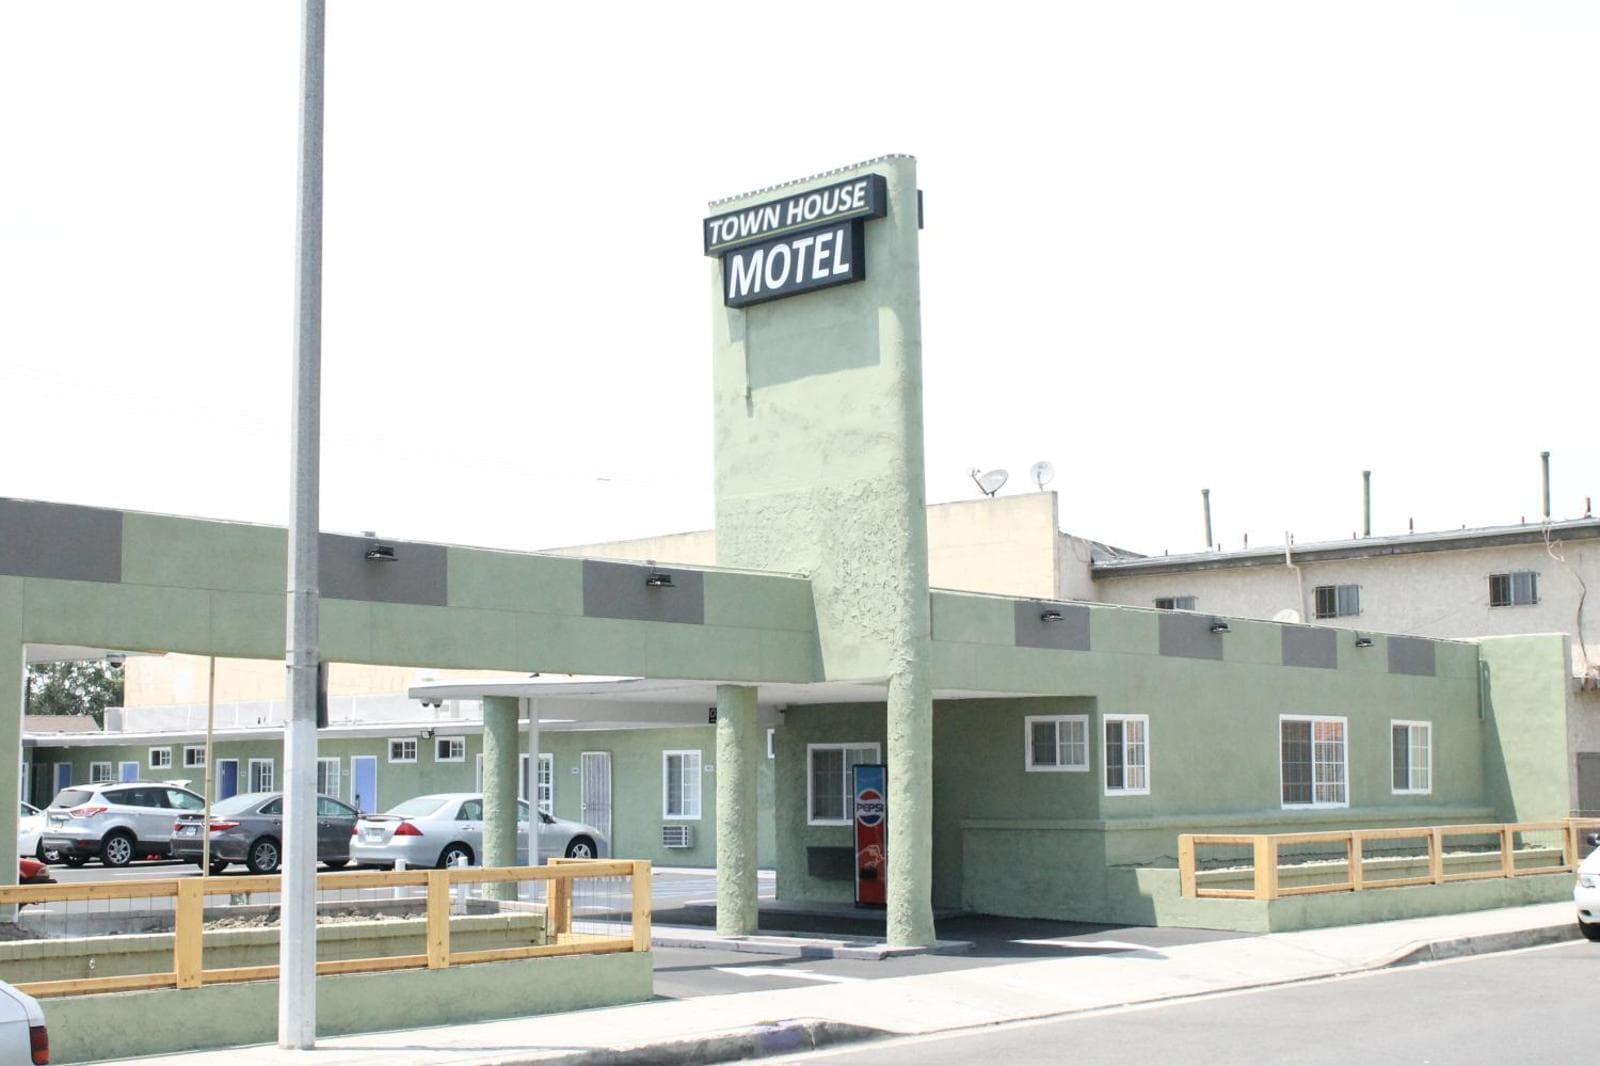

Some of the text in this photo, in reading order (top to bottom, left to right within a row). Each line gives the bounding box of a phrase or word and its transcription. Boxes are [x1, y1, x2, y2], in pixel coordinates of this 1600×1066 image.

[710, 181, 868, 245] TOWN HOUSE
[729, 229, 850, 299] MOTEL
[856, 803, 884, 812] PEPSI
